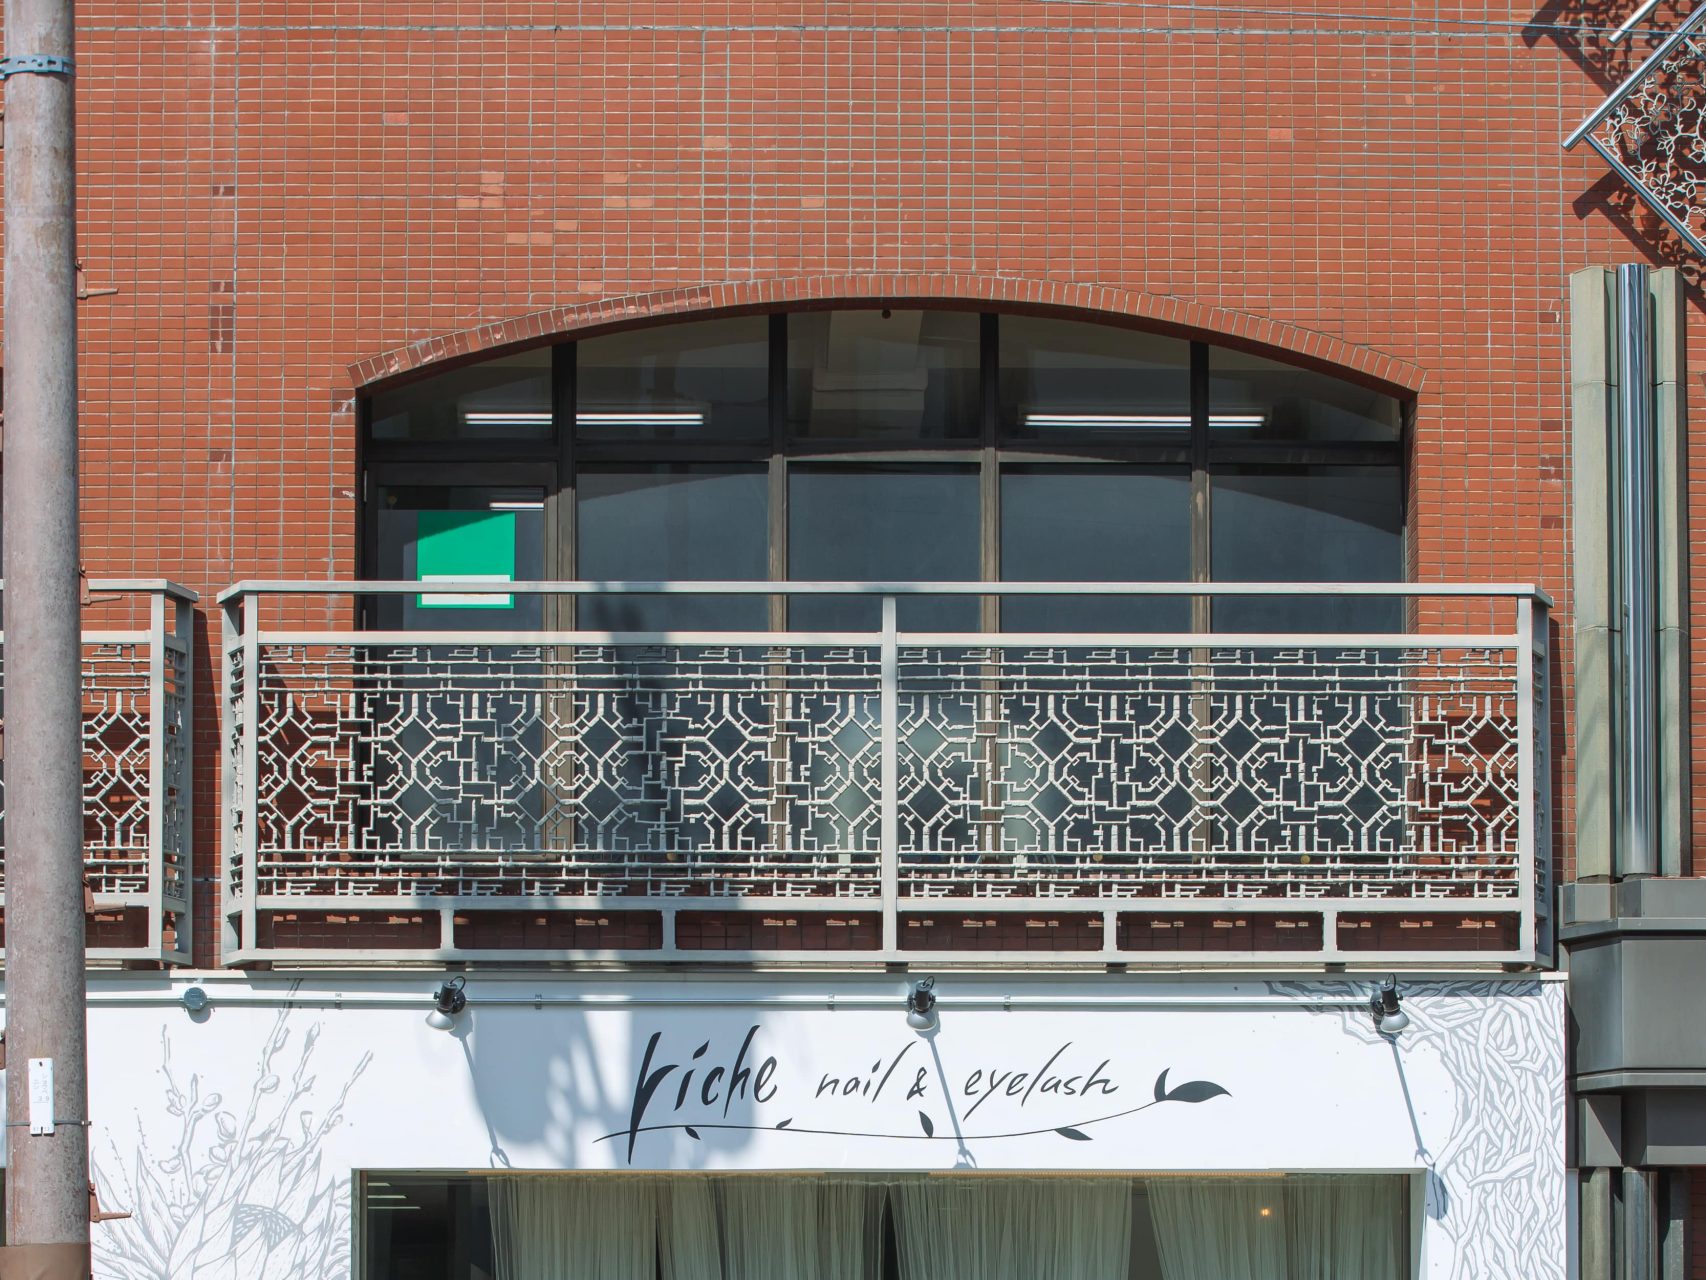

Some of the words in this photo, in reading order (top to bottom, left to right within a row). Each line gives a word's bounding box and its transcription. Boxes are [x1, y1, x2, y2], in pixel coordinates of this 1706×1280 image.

[628, 1024, 778, 1165] riche
[815, 1040, 917, 1102] nail
[907, 1068, 928, 1102] &
[962, 1041, 1120, 1122] eyelash
